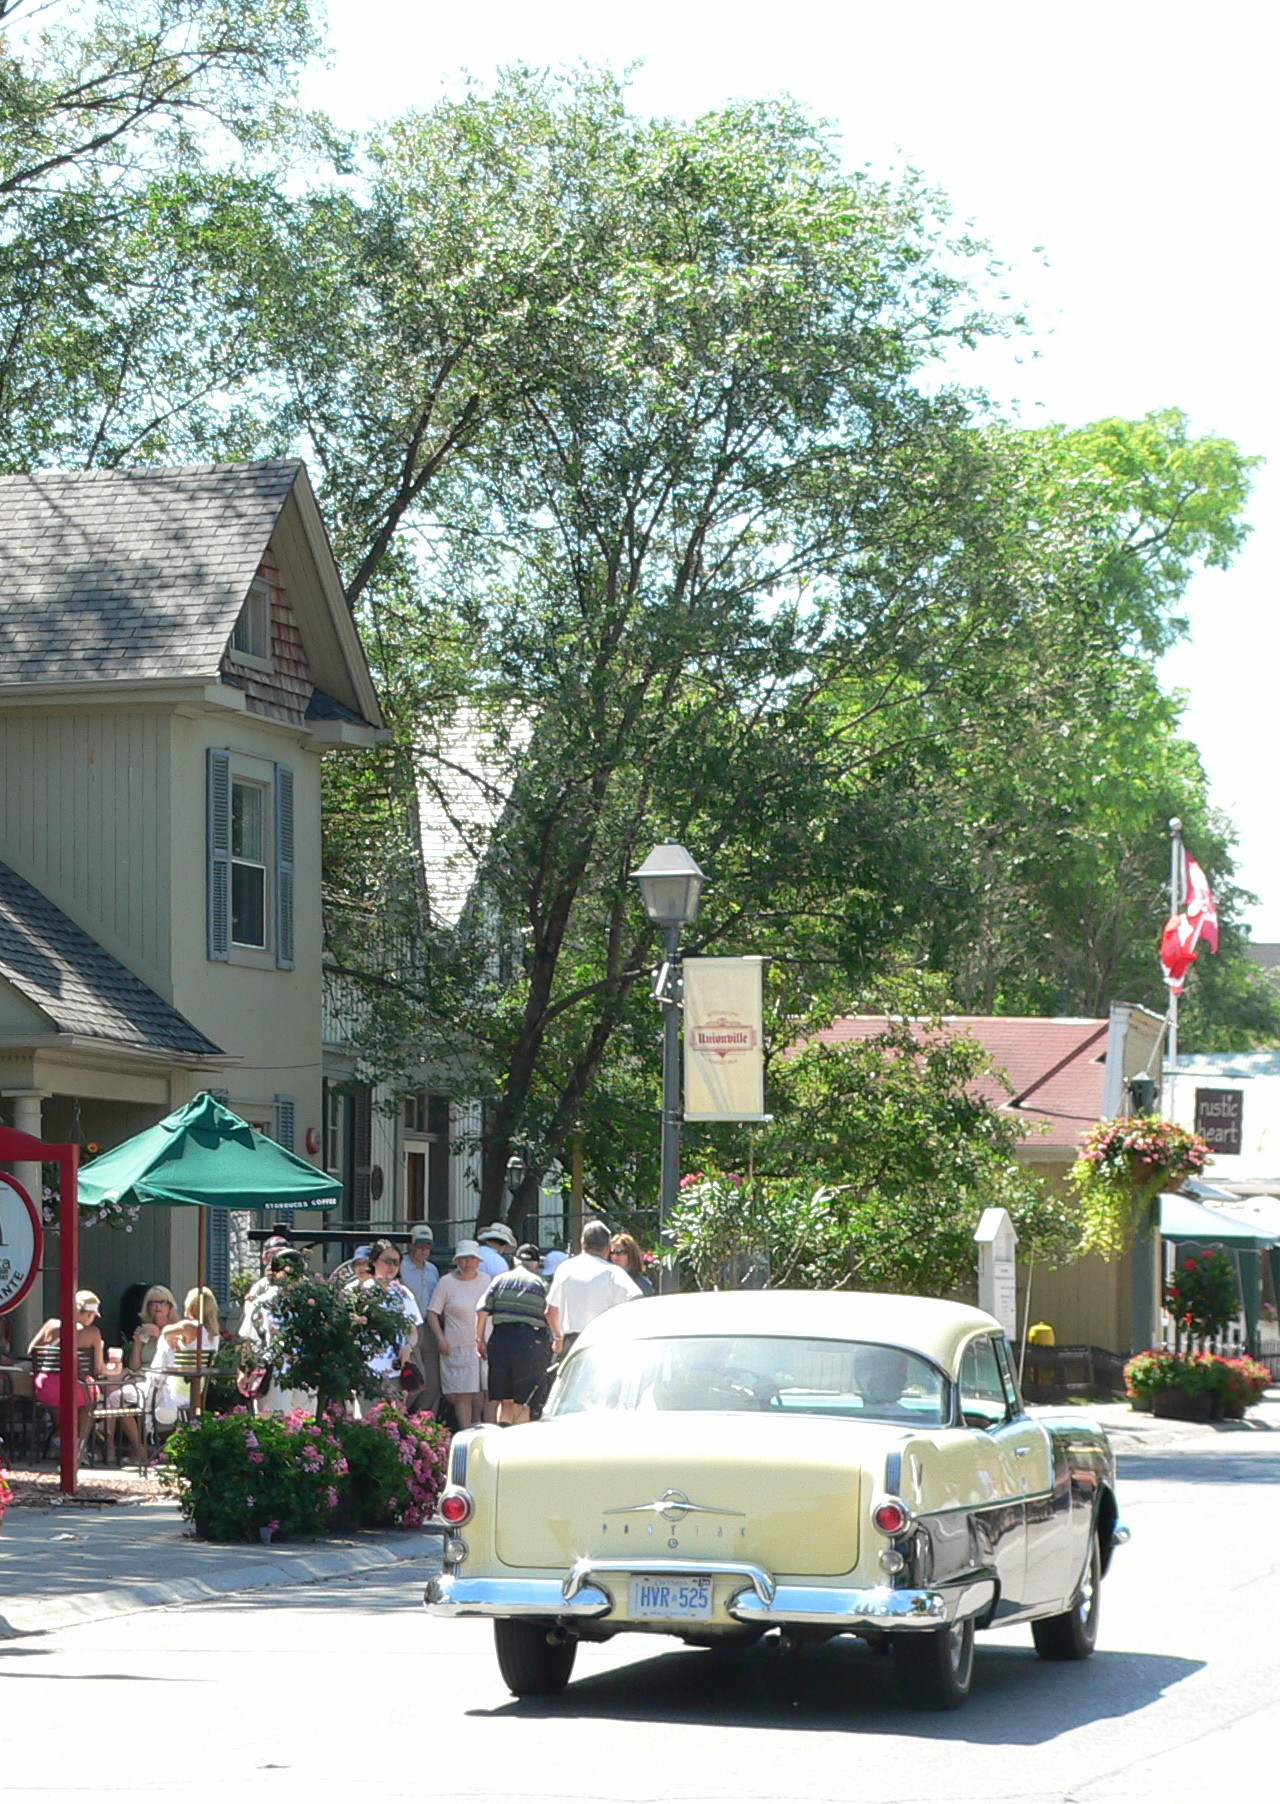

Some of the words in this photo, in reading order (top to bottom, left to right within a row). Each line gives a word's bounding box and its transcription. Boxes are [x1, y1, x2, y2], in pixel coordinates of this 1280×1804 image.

[698, 1032, 748, 1044] Unionville
[1200, 1094, 1239, 1118] rustic
[1197, 1120, 1239, 1144] heart
[264, 1201, 309, 1210] STARBUCKS
[311, 1197, 338, 1206] COFFEE
[640, 1586, 670, 1608] HVR
[679, 1587, 708, 1609] 525
